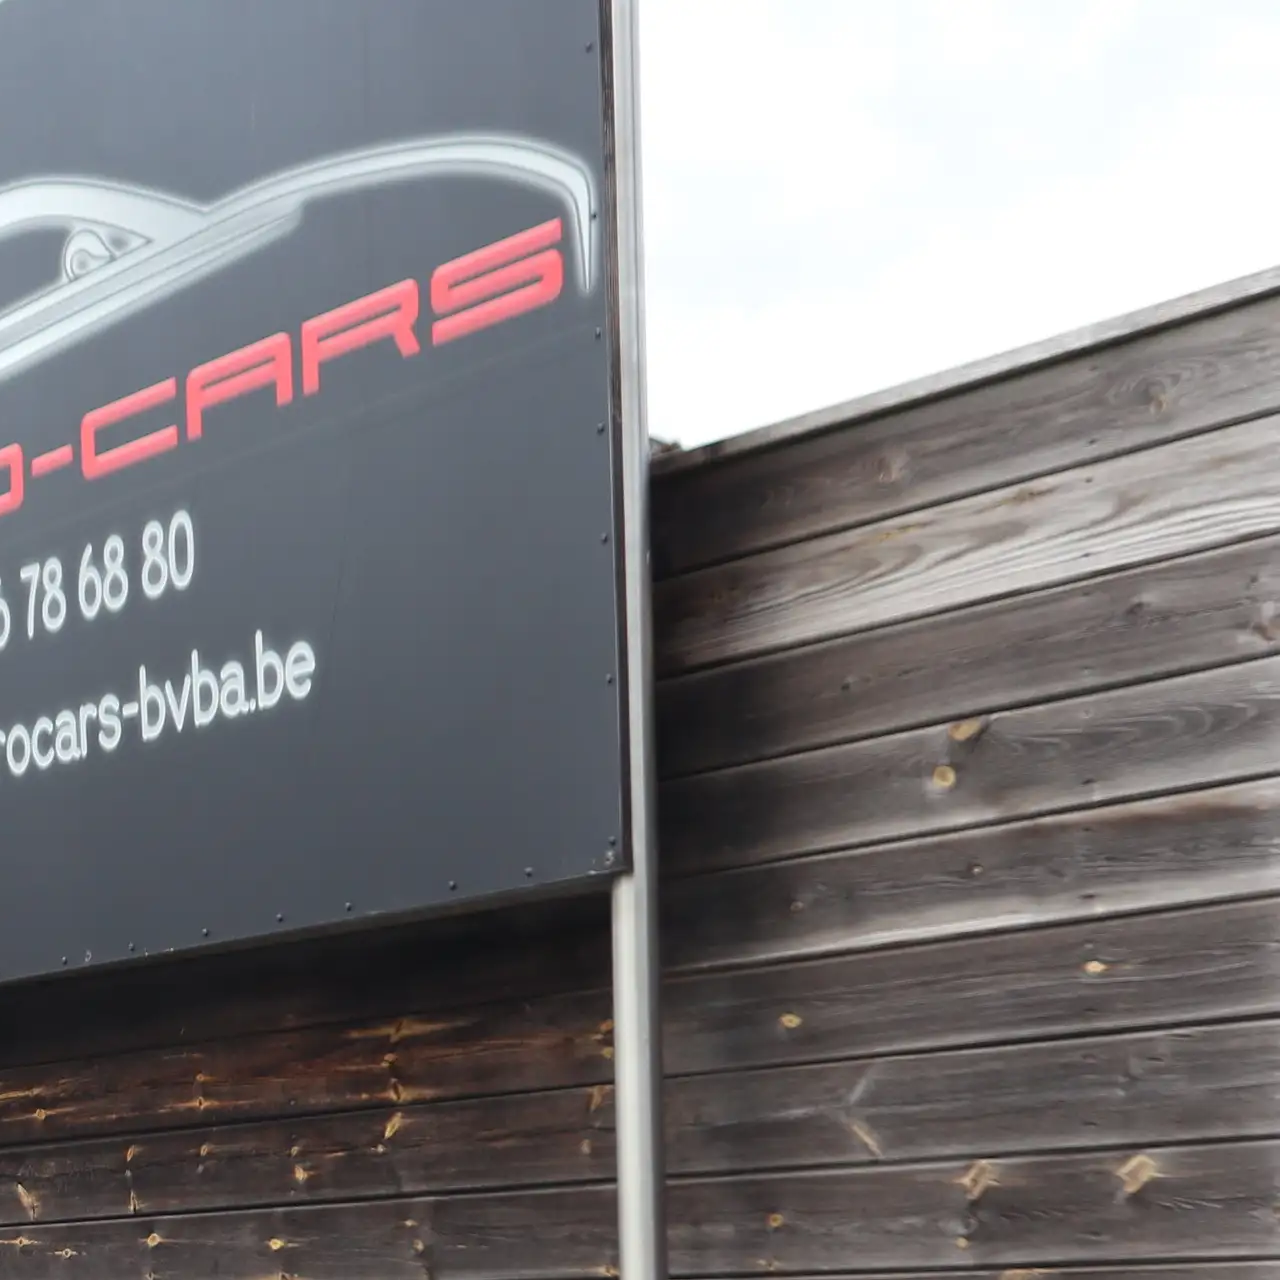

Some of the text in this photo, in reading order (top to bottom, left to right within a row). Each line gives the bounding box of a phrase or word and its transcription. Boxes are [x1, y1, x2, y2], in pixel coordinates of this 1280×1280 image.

[20, 556, 67, 638] 78
[78, 534, 129, 620] 68
[141, 510, 195, 600] 80
